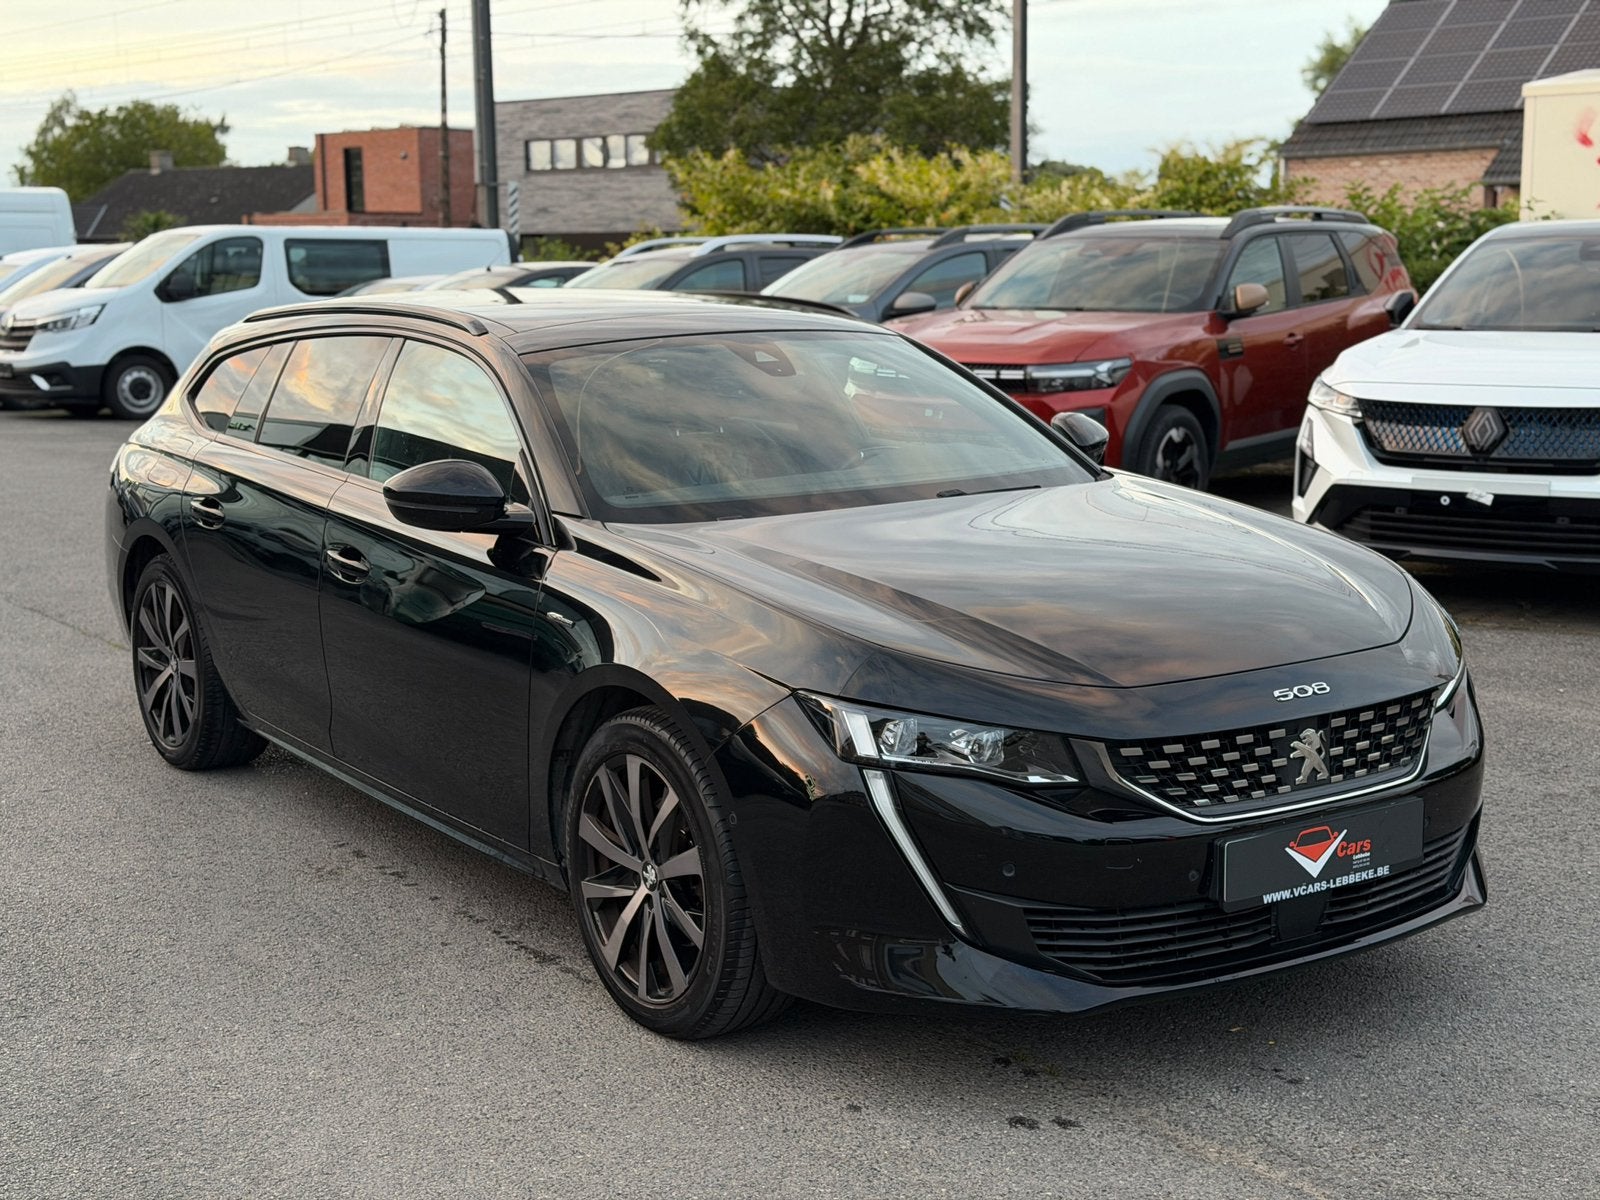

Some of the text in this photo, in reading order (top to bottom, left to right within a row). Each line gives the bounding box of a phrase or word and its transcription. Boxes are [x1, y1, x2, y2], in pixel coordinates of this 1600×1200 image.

[1273, 682, 1330, 701] 508
[1337, 840, 1372, 858] Cars
[1262, 865, 1391, 904] WWW.VCARS-LEBBEKE.BE
